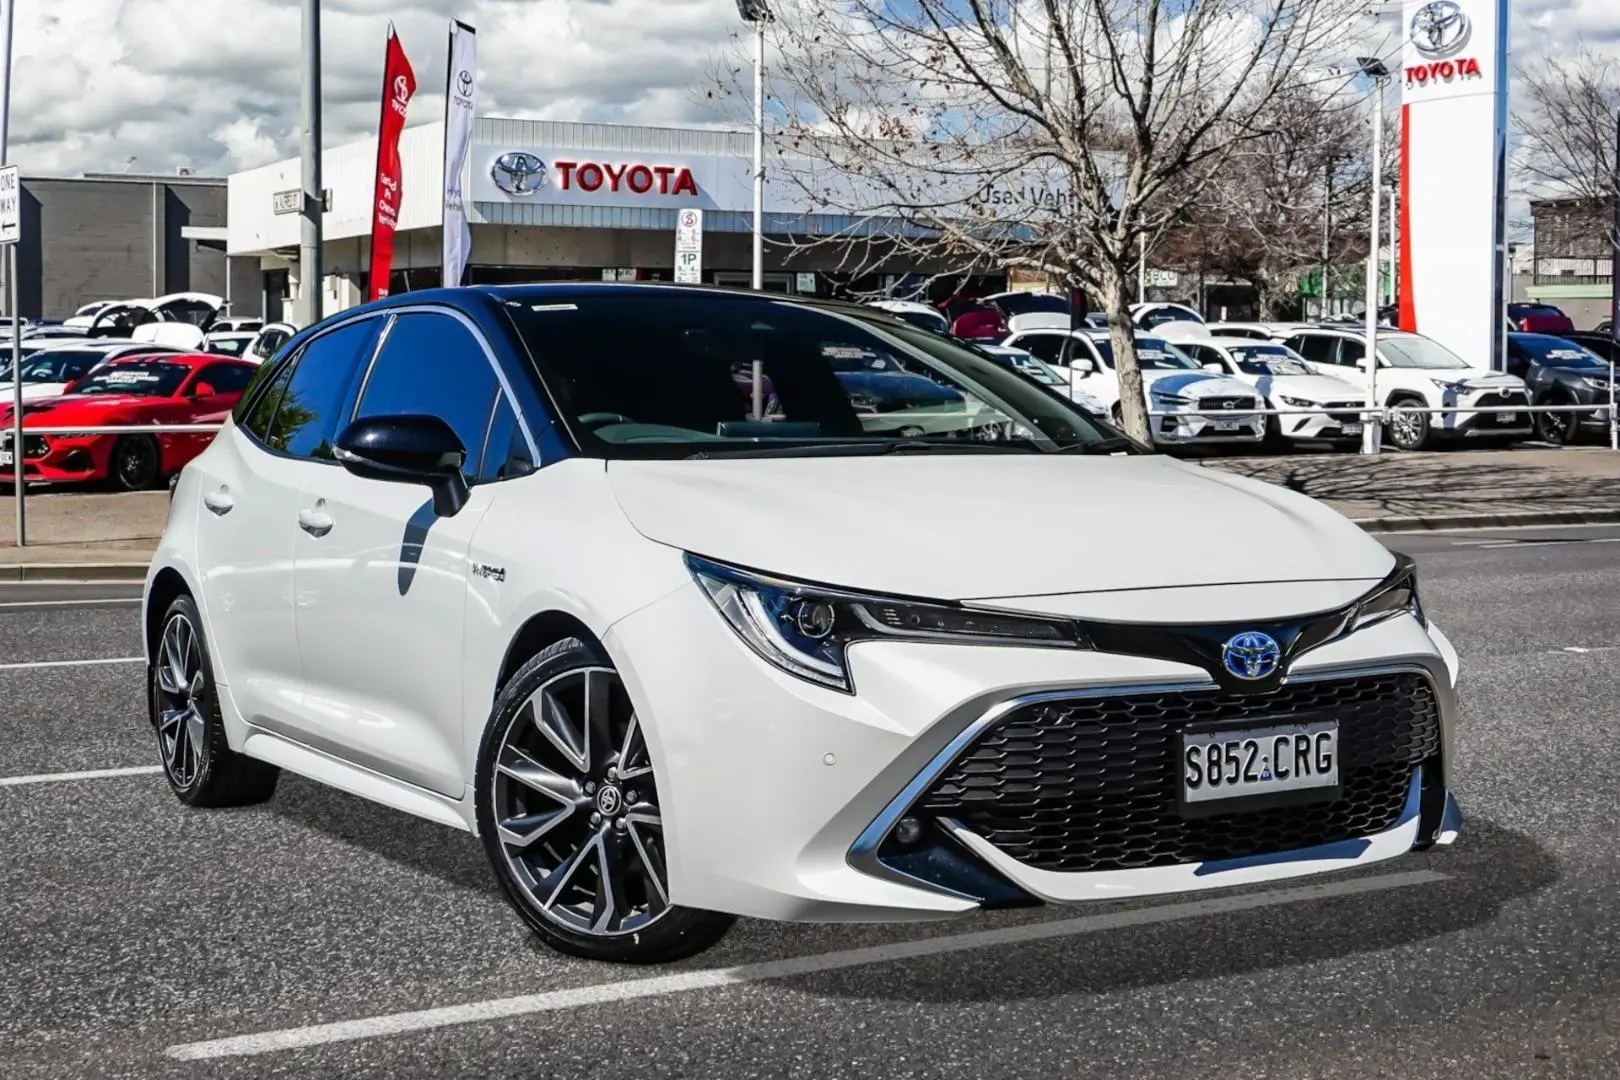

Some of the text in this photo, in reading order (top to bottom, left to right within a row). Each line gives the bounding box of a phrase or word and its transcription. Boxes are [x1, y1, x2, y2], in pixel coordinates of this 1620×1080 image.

[1404, 58, 1480, 83] TOYOTA
[0, 173, 15, 191] ONE
[555, 161, 698, 196] TOYOTA
[0, 196, 16, 214] WAY
[681, 253, 697, 265] 1P
[1185, 732, 1332, 790] S852 CRG
